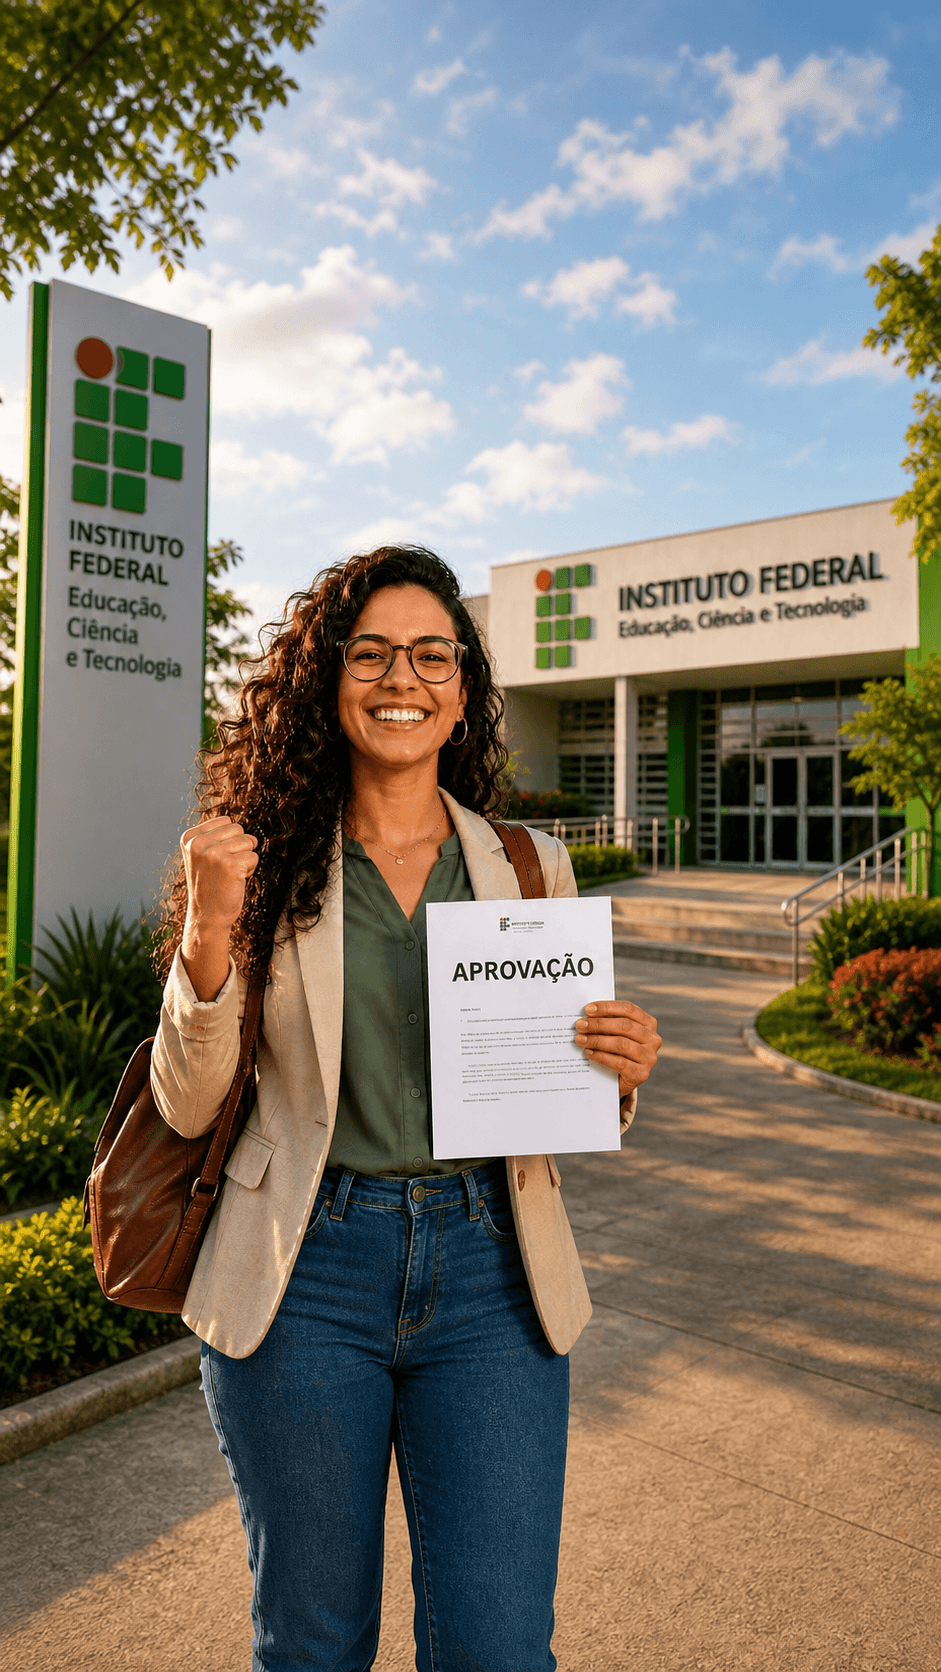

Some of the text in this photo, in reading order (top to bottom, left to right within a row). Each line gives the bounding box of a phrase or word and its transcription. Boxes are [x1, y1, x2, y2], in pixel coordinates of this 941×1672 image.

[69, 519, 184, 559] INSTITUTO
[69, 550, 169, 587] FEDERAL
[619, 552, 884, 611] INSTITUTO FEDERAL
[68, 586, 167, 622] Educação,
[619, 595, 866, 638] Educação, Ciência e Tecnologia
[67, 616, 139, 645] Ciência
[66, 648, 182, 682] e Tecnologia
[452, 953, 594, 983] APROVAÇÃO
